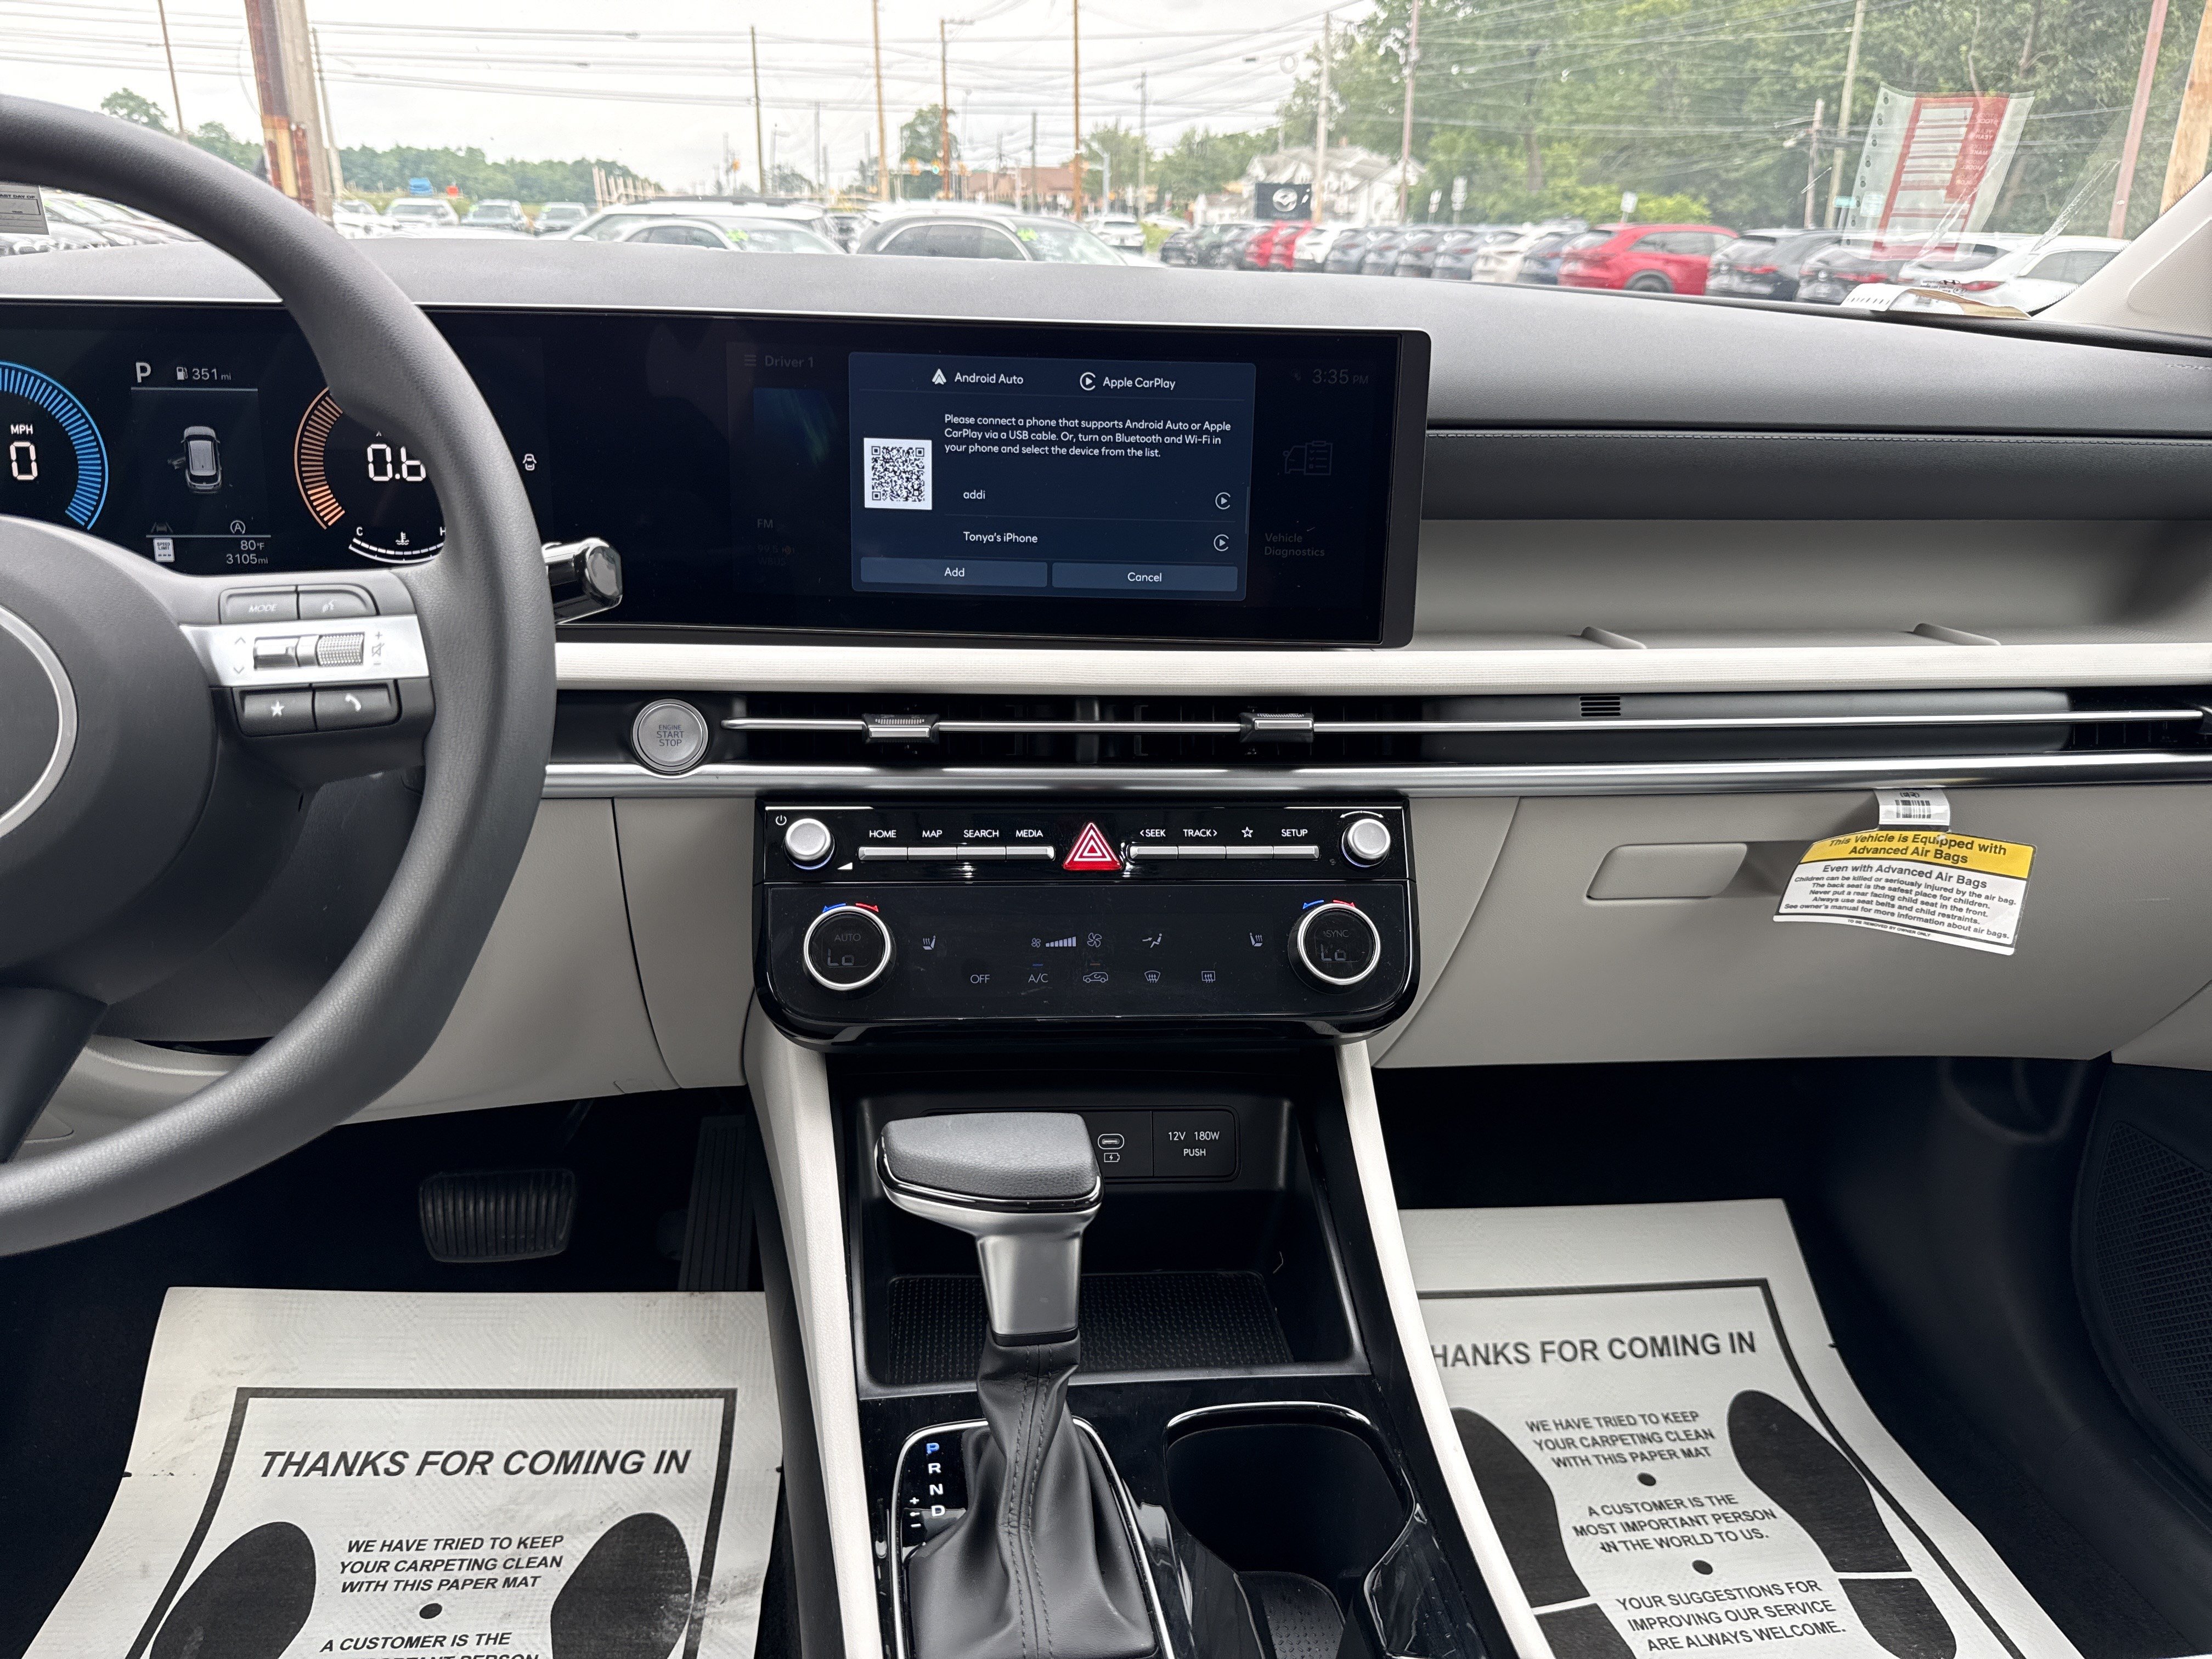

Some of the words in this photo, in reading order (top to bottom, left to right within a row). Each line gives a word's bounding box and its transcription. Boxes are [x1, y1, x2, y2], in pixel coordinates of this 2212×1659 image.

[765, 355, 805, 368] Driver
[809, 356, 814, 368] 1
[135, 362, 151, 383] P
[192, 369, 218, 380] 351
[955, 373, 996, 383] Android
[998, 374, 1024, 384] Auto
[1312, 368, 1350, 385] 3:35
[1353, 375, 1369, 385] PM
[1103, 377, 1132, 389] Apple
[1135, 377, 1176, 390] CarPlay
[945, 414, 975, 424] Please
[977, 417, 1016, 426] connect
[1026, 417, 1057, 428] phone
[1058, 418, 1079, 427] that
[1081, 419, 1123, 430] supports
[1125, 419, 1163, 429] Android
[1165, 420, 1189, 430] Auto
[1203, 421, 1231, 432] Apple
[10, 424, 33, 435] MPH
[944, 428, 983, 440] CarPlay
[984, 430, 998, 439] via
[1009, 430, 1028, 440] USB
[1031, 431, 1059, 441] cable.
[1060, 432, 1076, 442] Or,
[1078, 433, 1099, 441] turn
[1116, 433, 1162, 443] Bluetooth
[1164, 435, 1182, 444] and
[1185, 435, 1210, 444] Wi-Fi
[1212, 436, 1221, 444] in
[945, 444, 967, 454] your
[969, 443, 998, 454] phone
[1001, 444, 1019, 454] and
[1022, 445, 1049, 455] select
[1051, 445, 1067, 455] the
[1069, 446, 1099, 455] device
[1102, 447, 1125, 456] from
[1127, 448, 1143, 456] the
[1145, 448, 1161, 458] list.
[9, 441, 38, 480] 0
[963, 489, 986, 500] addi
[757, 519, 774, 529] FM
[356, 527, 363, 537] C
[440, 527, 446, 537] H
[963, 532, 1001, 544] Tonya's
[1003, 533, 1038, 543] iPhone
[1265, 533, 1303, 543] Vehicle
[1264, 546, 1325, 558] Diagnostics
[944, 567, 965, 577] Add
[1127, 572, 1162, 583] Cancel
[249, 605, 278, 613] MODE
[869, 830, 896, 838] HOME
[922, 830, 943, 838] MAP
[963, 830, 998, 838] SEARCH
[1015, 829, 1043, 837] MEDIA
[1282, 829, 1308, 837] SETUP
[1829, 838, 1851, 847] This
[1855, 833, 1896, 843] Vehicle
[1898, 834, 1908, 843] is
[1911, 834, 1975, 850] Equipped
[1978, 843, 2007, 856] with
[1848, 846, 1909, 855] Advanced
[1910, 847, 1931, 857] Air
[1933, 849, 1968, 865] Bags
[1875, 865, 1932, 879] Advanced
[1935, 871, 1953, 882] Air
[1956, 874, 1987, 889] Bags
[1884, 878, 1922, 889] seriously
[1925, 883, 1954, 894] injured
[1956, 888, 1966, 896] by
[1998, 895, 2016, 906] bag.
[1897, 910, 1945, 926] information
[1946, 923, 1972, 933] about
[1986, 929, 2010, 939] bags.
[834, 933, 861, 941] AUTO
[1327, 929, 1349, 938] SYNC
[970, 974, 990, 984] OFF
[1028, 973, 1049, 984] A/C
[1169, 1131, 1186, 1141] 12V
[1194, 1131, 1220, 1141] 180W
[1183, 1148, 1206, 1156] PUSH
[1432, 1341, 1531, 1367] HANKS
[1539, 1339, 1600, 1363] FOR
[1607, 1333, 1721, 1360] COMING
[1728, 1330, 1756, 1354] IN
[926, 1443, 940, 1454] P
[261, 1450, 410, 1477] THANKS
[415, 1449, 494, 1476] FOR
[504, 1449, 646, 1476] COMING
[653, 1449, 692, 1474] IN
[928, 1463, 941, 1474] R
[929, 1483, 944, 1496] N
[931, 1505, 945, 1516] D
[347, 1539, 376, 1553] WE
[380, 1538, 429, 1552] HAVE
[433, 1537, 484, 1551] TRIED
[490, 1537, 513, 1550] TO
[516, 1535, 564, 1549] KEEP
[340, 1560, 391, 1574] YOUR
[394, 1558, 498, 1572] CARPETING
[503, 1555, 564, 1570] CLEAN
[341, 1579, 389, 1593] WITH
[393, 1579, 433, 1592] THIS
[437, 1578, 498, 1591] PAPER
[502, 1576, 542, 1589] MAT
[319, 1639, 334, 1652] A
[339, 1635, 447, 1651] CUSTOMER
[450, 1634, 470, 1647] IS
[475, 1632, 512, 1646] THE
[1647, 1637, 1684, 1651] ARE
[1685, 1629, 1753, 1648] ALWAYS
[1752, 1621, 1847, 1641] WELCOME.
